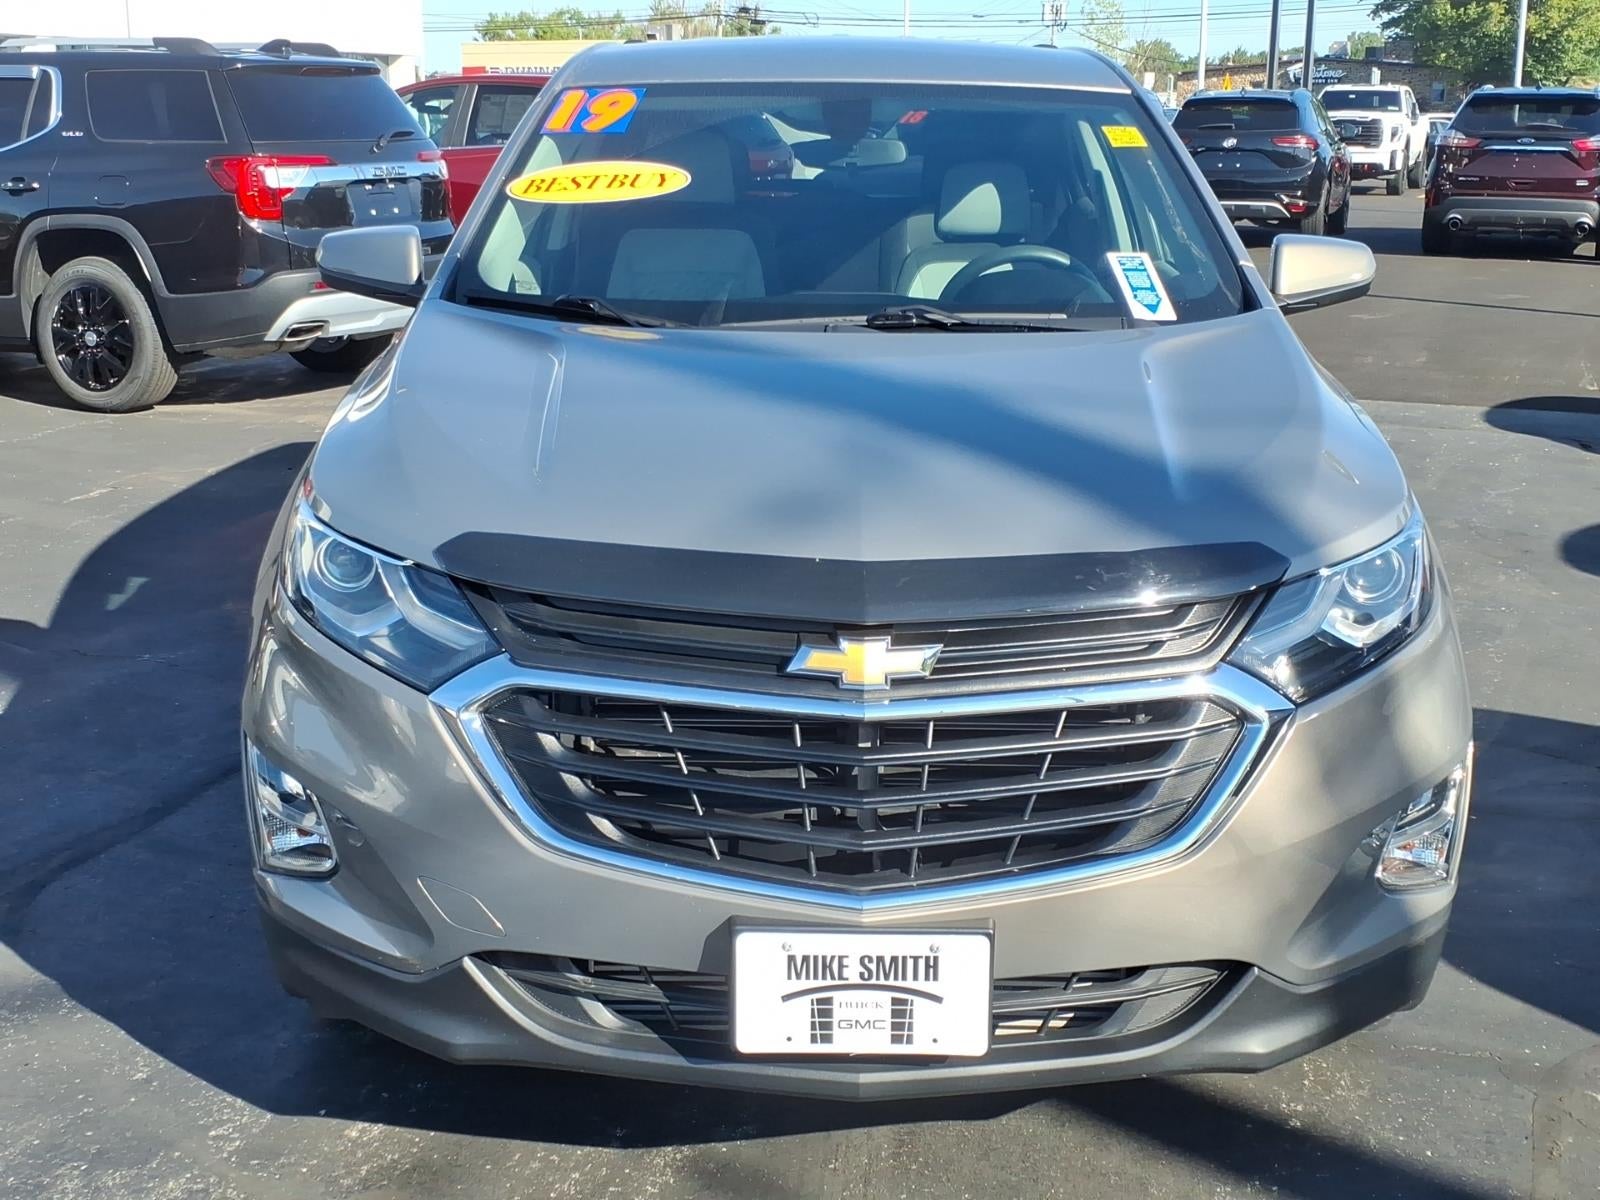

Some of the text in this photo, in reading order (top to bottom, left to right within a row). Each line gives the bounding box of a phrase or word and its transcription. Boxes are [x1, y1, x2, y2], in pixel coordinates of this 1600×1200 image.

[544, 88, 638, 133] 19
[372, 165, 407, 177] GMC
[523, 173, 677, 194] BEST BUY
[786, 954, 940, 982] MIKE SMITH
[838, 1001, 884, 1009] BUICK
[837, 1019, 887, 1030] GMC
